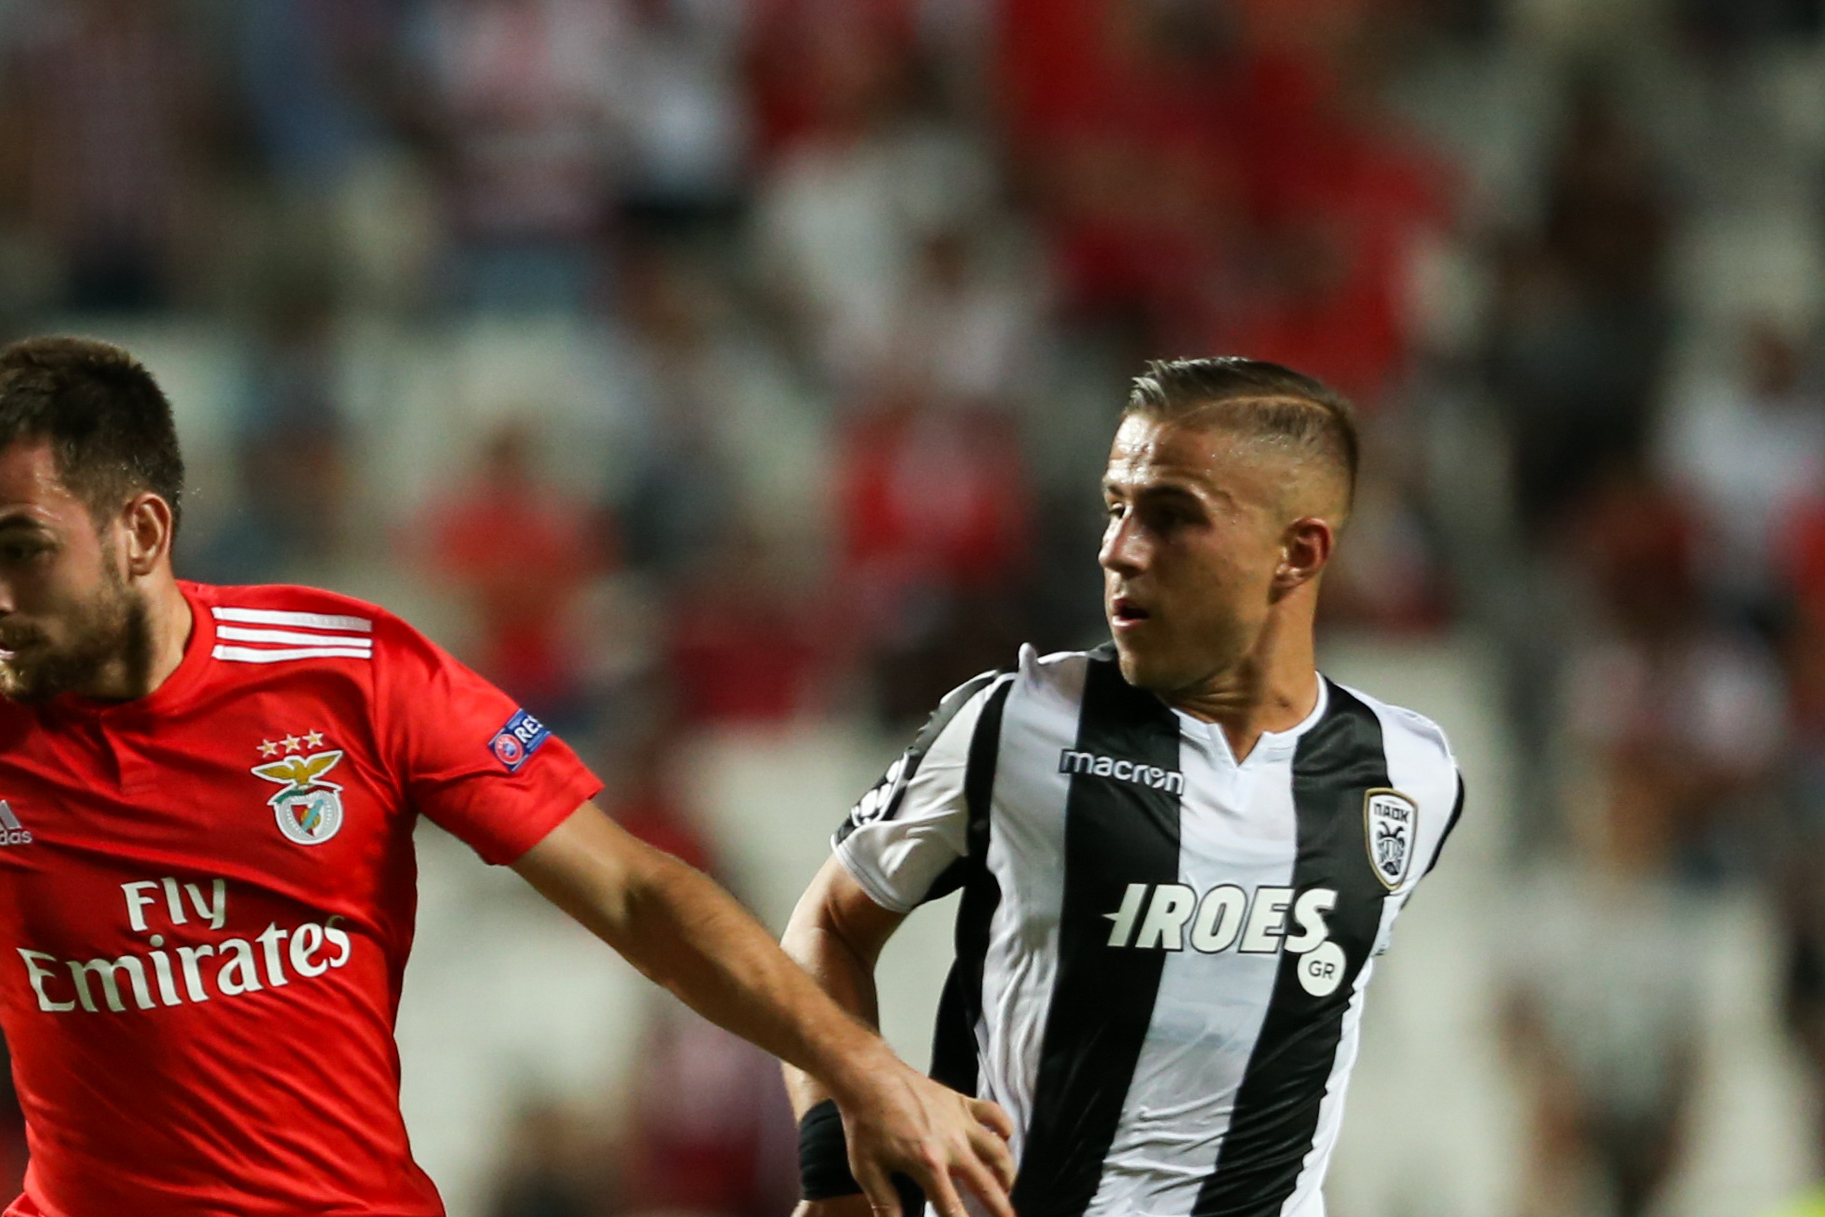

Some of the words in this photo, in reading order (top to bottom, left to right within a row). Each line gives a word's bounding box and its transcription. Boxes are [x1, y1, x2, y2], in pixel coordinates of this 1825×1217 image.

[1062, 750, 1185, 796] macron
[121, 877, 226, 932] Fly
[1103, 883, 1338, 954] IROES
[16, 915, 352, 1013] Emirates
[1308, 960, 1335, 980] GR
